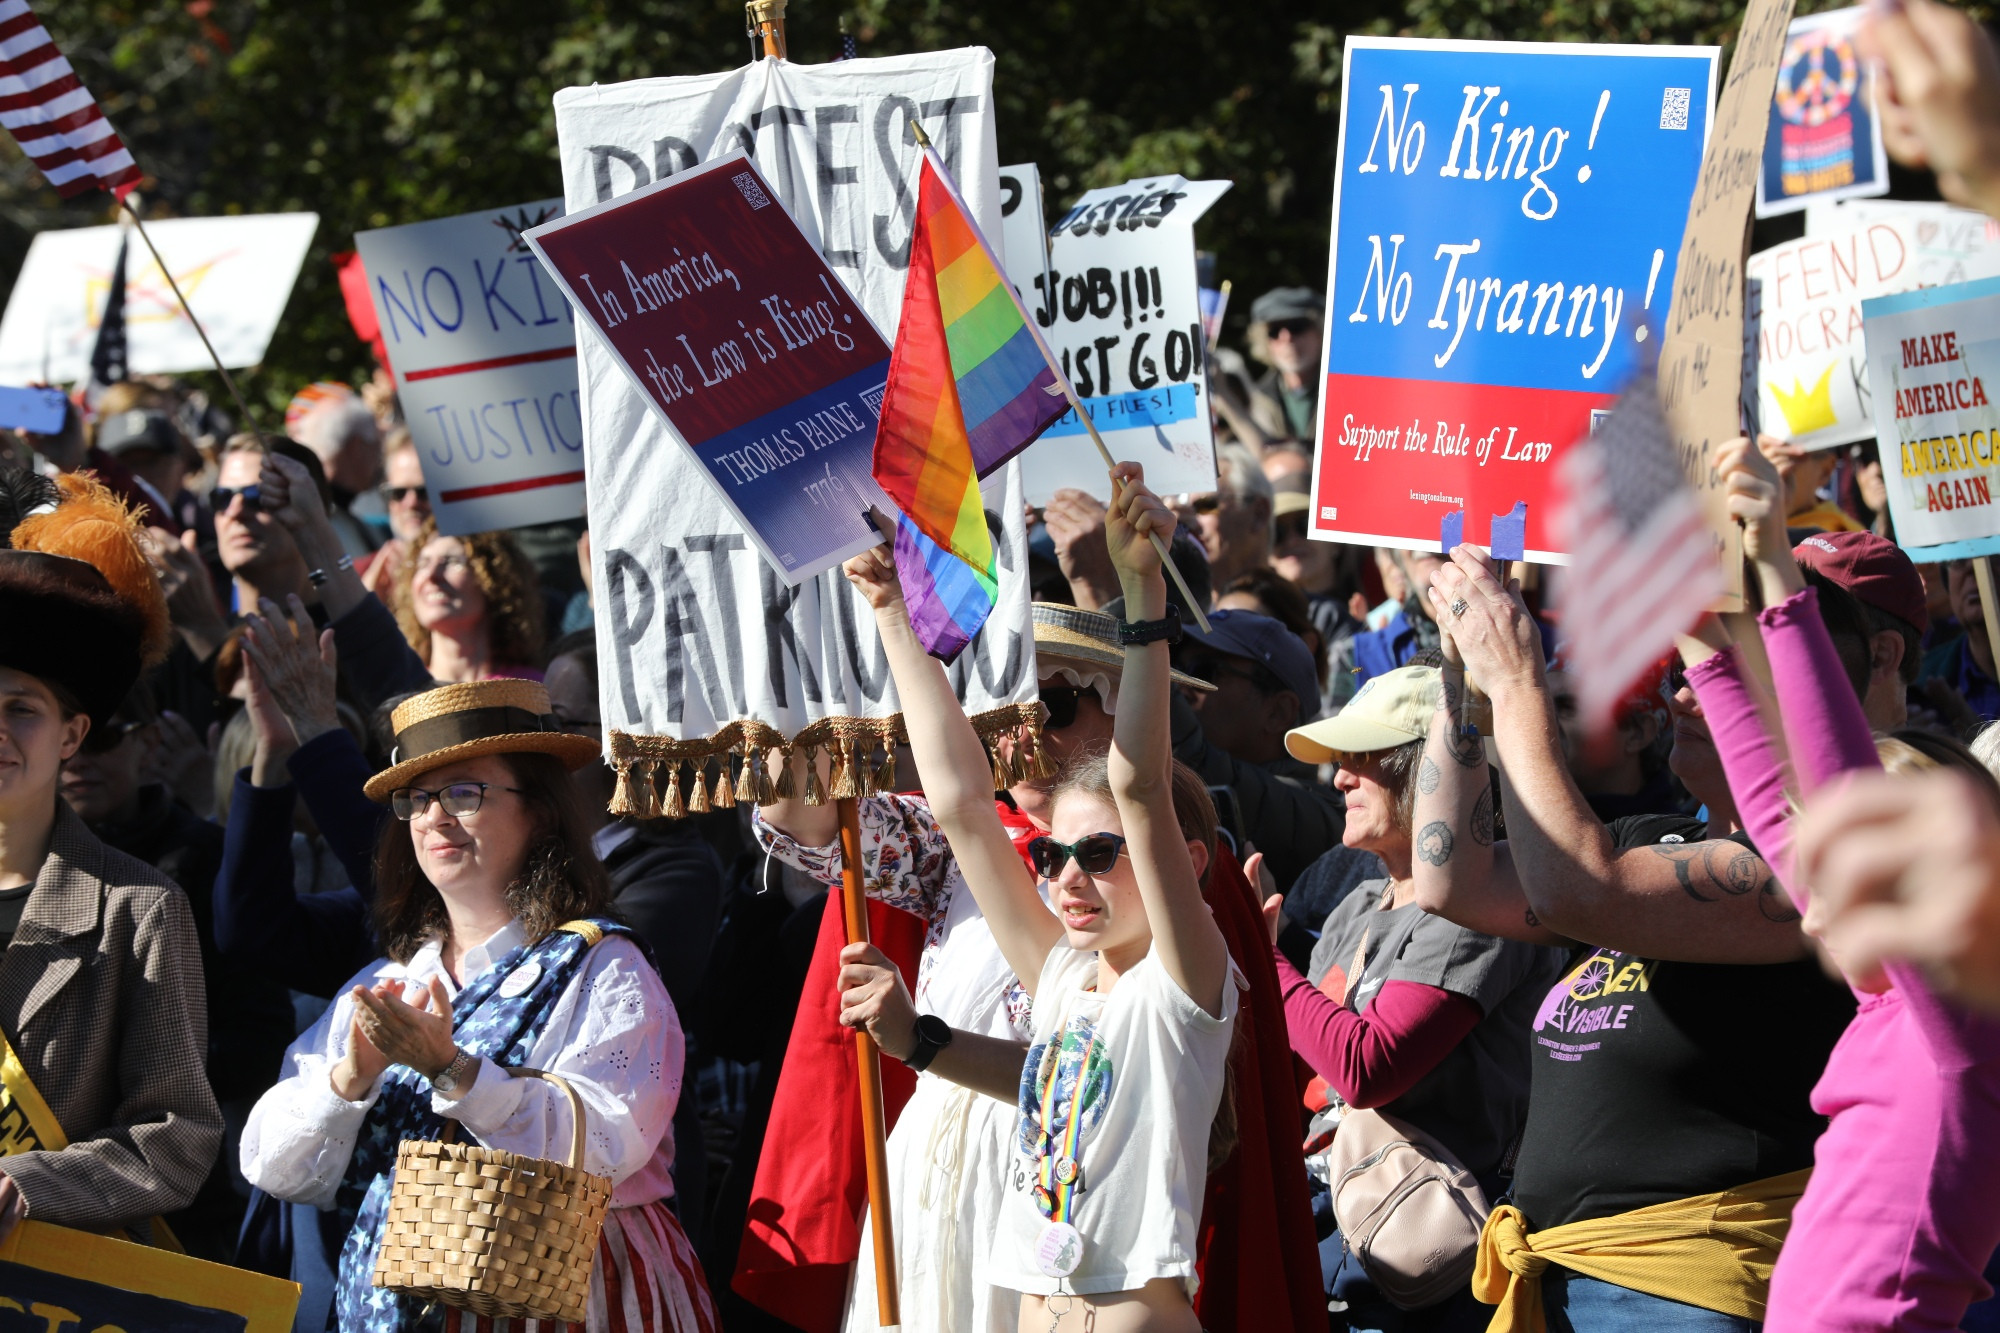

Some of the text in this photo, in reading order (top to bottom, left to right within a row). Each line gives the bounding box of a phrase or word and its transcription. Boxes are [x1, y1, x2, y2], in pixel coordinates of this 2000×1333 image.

[1359, 84, 1426, 175] No
[580, 247, 741, 329] In America,
[1034, 266, 1165, 330] JOB!!!
[1349, 234, 1413, 326] No
[1750, 224, 1906, 320] EFEND
[377, 266, 464, 343] NO
[645, 273, 855, 405] the Law is King!
[1901, 331, 1959, 369] MAKE
[425, 389, 582, 467] JUSTIC
[1896, 376, 1989, 419] AMERICA
[713, 401, 866, 486] THOMAS PAINE
[1338, 413, 1553, 466] Support the Rule of Law
[1901, 428, 2000, 478] AMERICA
[804, 463, 845, 511] 1776
[1410, 489, 1464, 507] lexingtonalarm.org
[1927, 475, 1992, 512] AGAIN
[1566, 1004, 1635, 1033] VISIBLE
